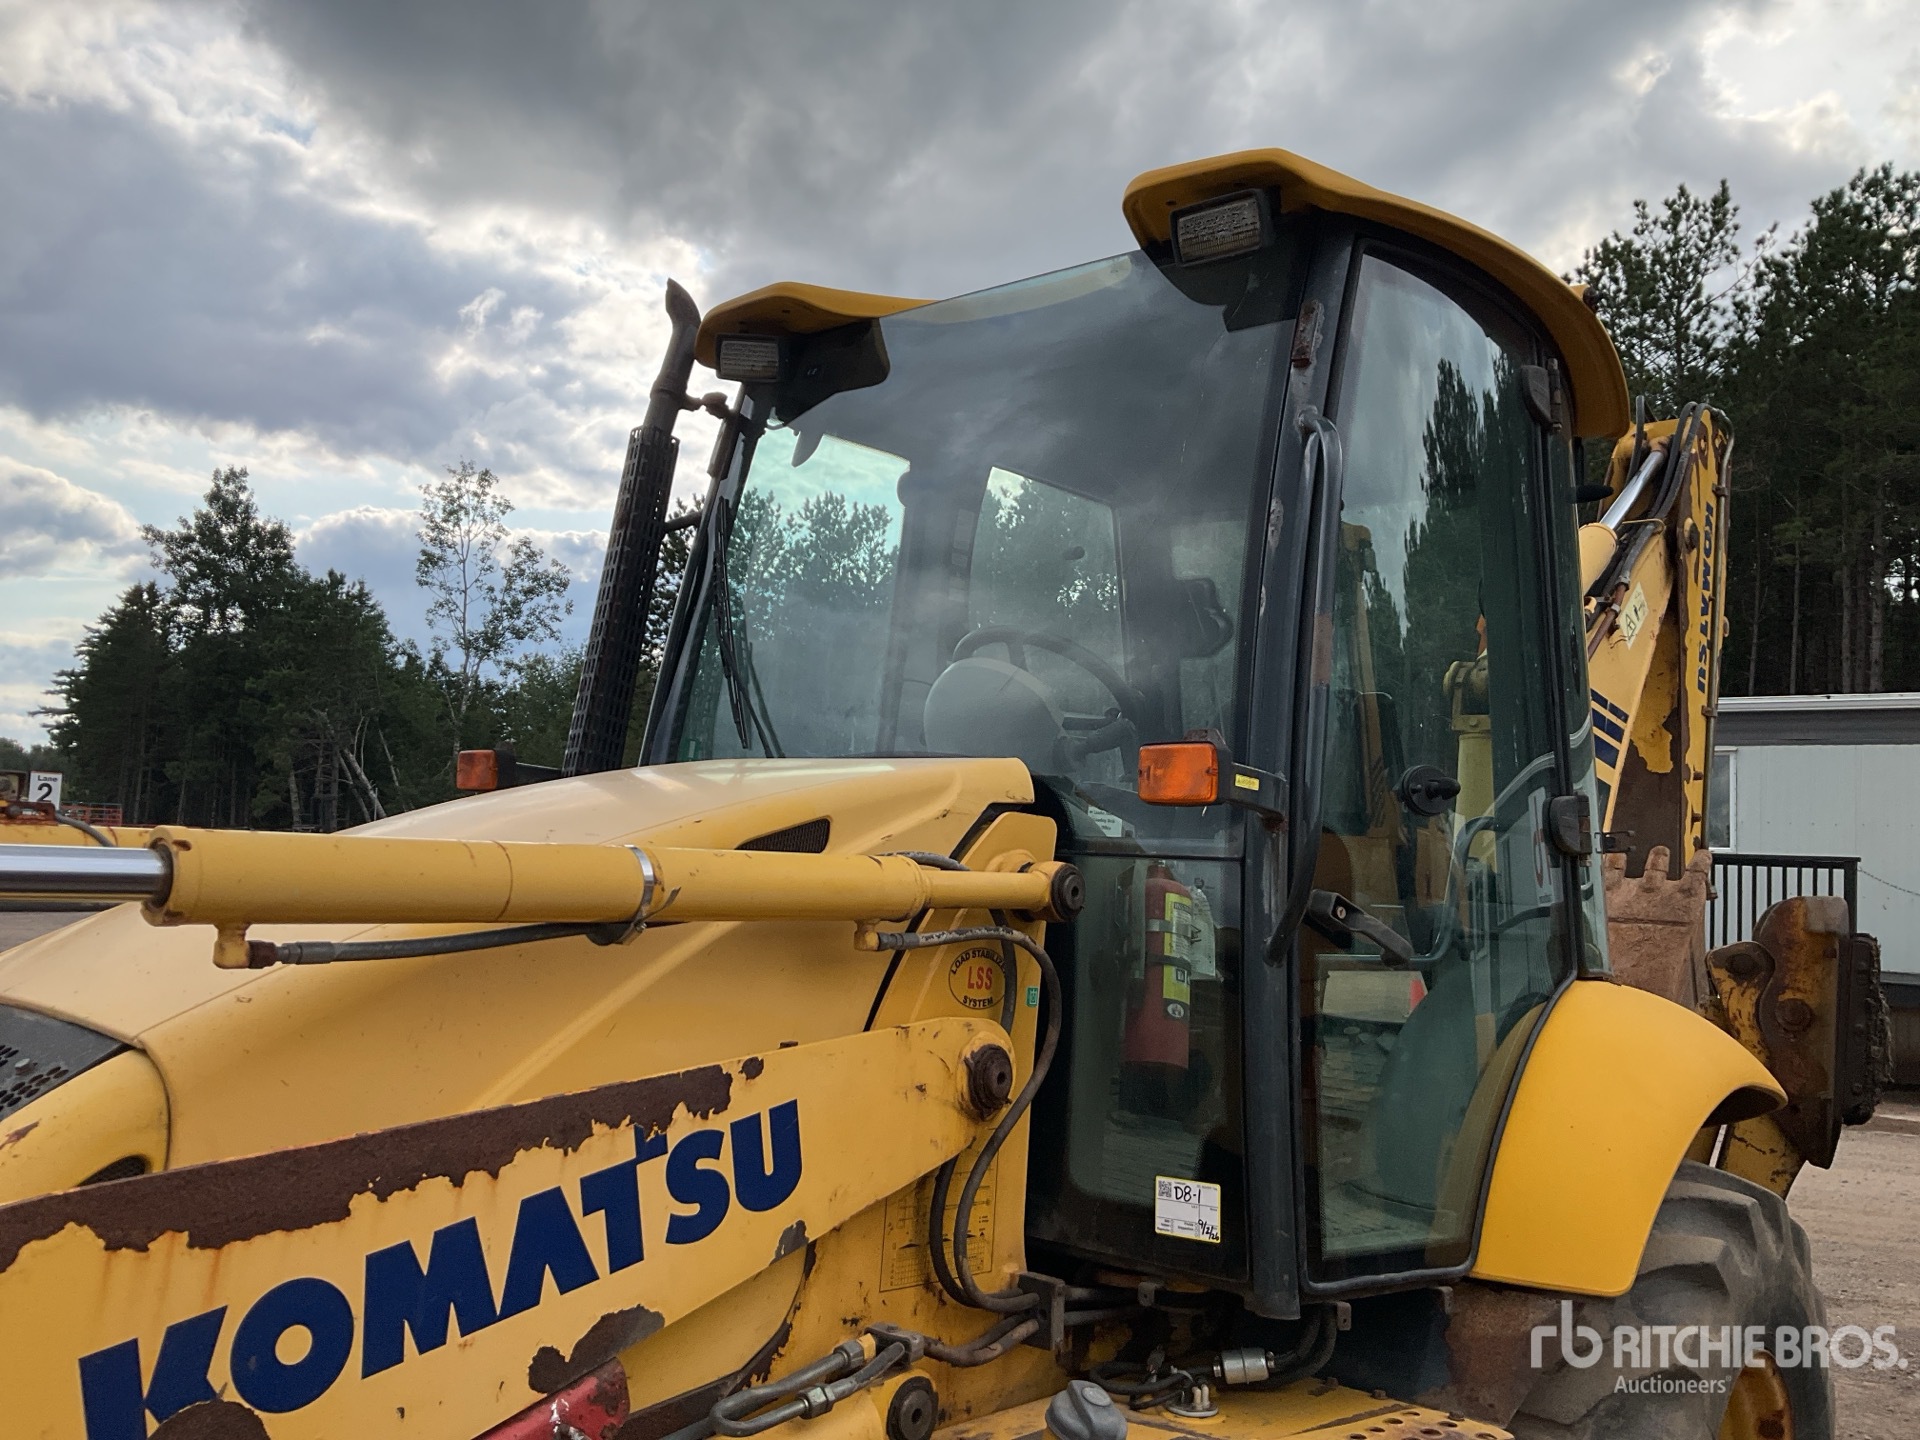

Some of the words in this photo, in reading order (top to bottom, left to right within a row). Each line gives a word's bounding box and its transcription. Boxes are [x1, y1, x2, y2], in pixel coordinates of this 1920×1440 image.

[1698, 501, 1713, 694] KOMATSU
[36, 783, 52, 802] 2
[951, 952, 971, 975] LOAD
[971, 949, 1006, 974] STABILIZ
[967, 966, 993, 990] LSS
[962, 995, 994, 1008] SYSTEM
[1173, 1185, 1201, 1204] D8-1
[79, 1098, 803, 1440] KOMATSU
